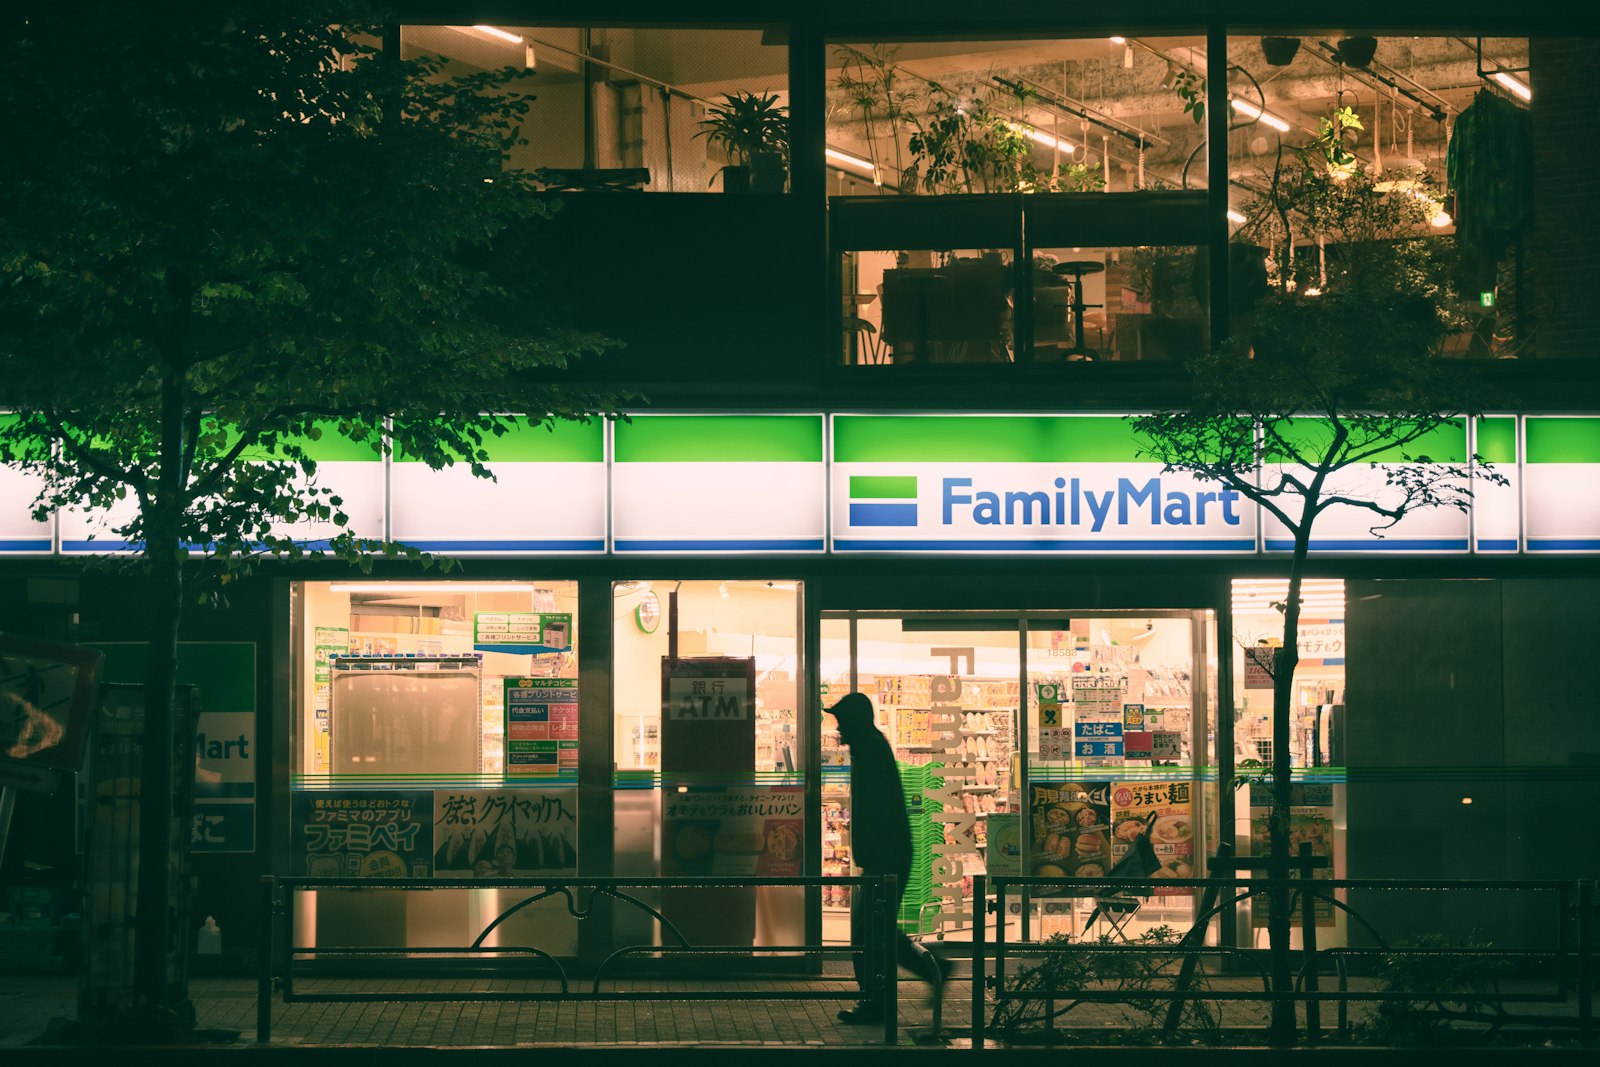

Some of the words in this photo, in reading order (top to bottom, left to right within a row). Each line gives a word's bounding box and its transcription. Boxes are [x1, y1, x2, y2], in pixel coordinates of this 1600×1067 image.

[942, 477, 1240, 532] FamilyMart
[1047, 649, 1077, 657] 18588
[692, 680, 725, 695] 銀行
[678, 695, 740, 718] ATM
[1126, 716, 1142, 725] AED
[1082, 725, 1115, 735] たばこ
[1082, 743, 1116, 755] お酒
[925, 647, 976, 931] FamilyMart
[314, 809, 411, 822] ファミマのアプリ
[304, 821, 421, 852] ファミペイ
